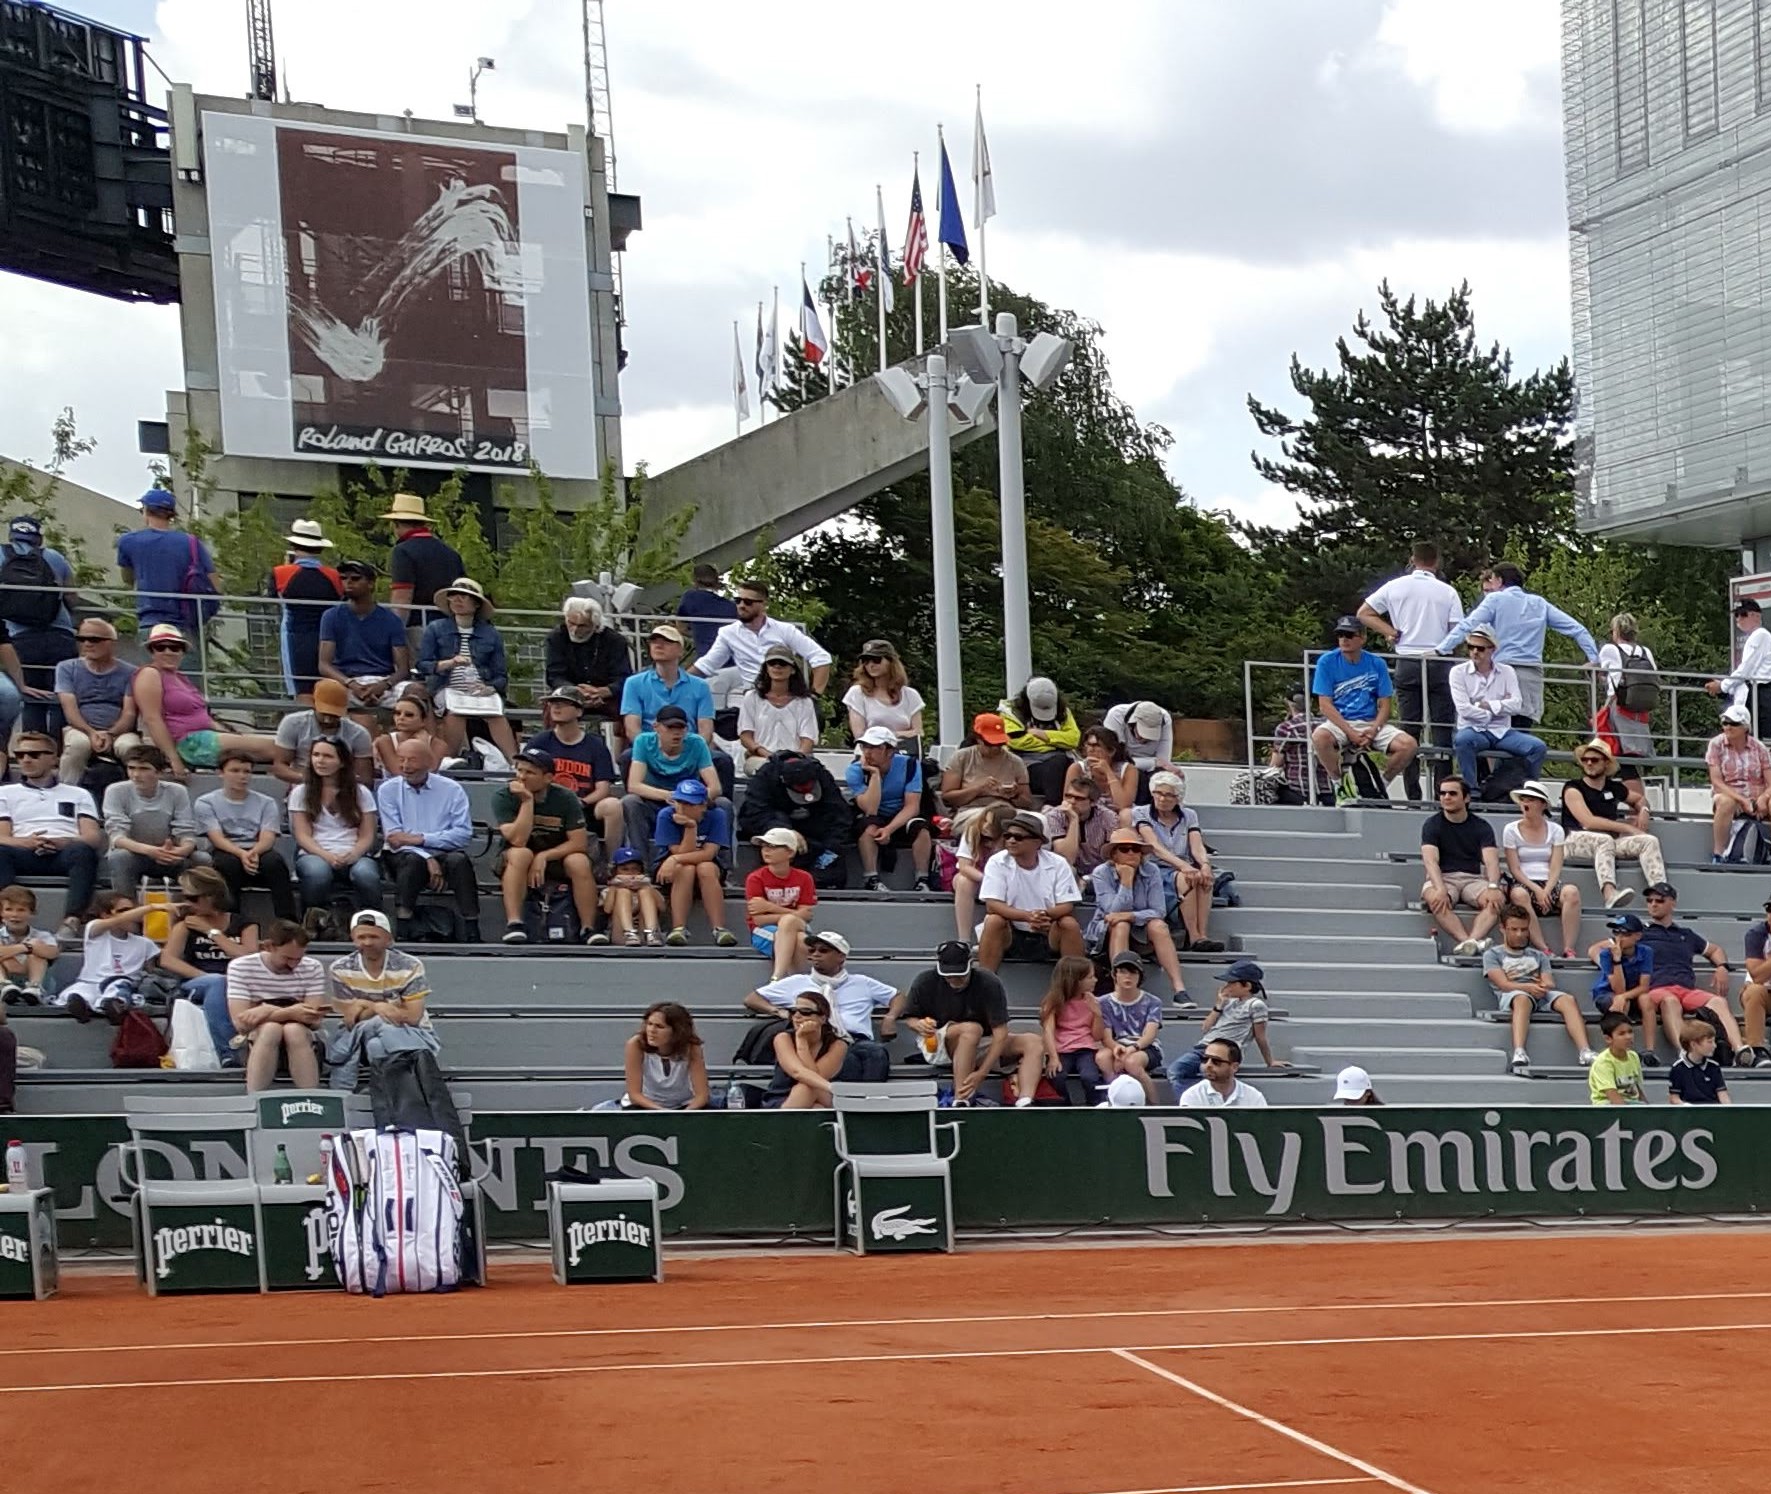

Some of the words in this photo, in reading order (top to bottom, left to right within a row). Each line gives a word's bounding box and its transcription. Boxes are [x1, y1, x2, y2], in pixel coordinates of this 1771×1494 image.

[473, 440, 527, 462] 2018
[1140, 1115, 1302, 1215] Fly
[1319, 1111, 1718, 1198] Emirates
